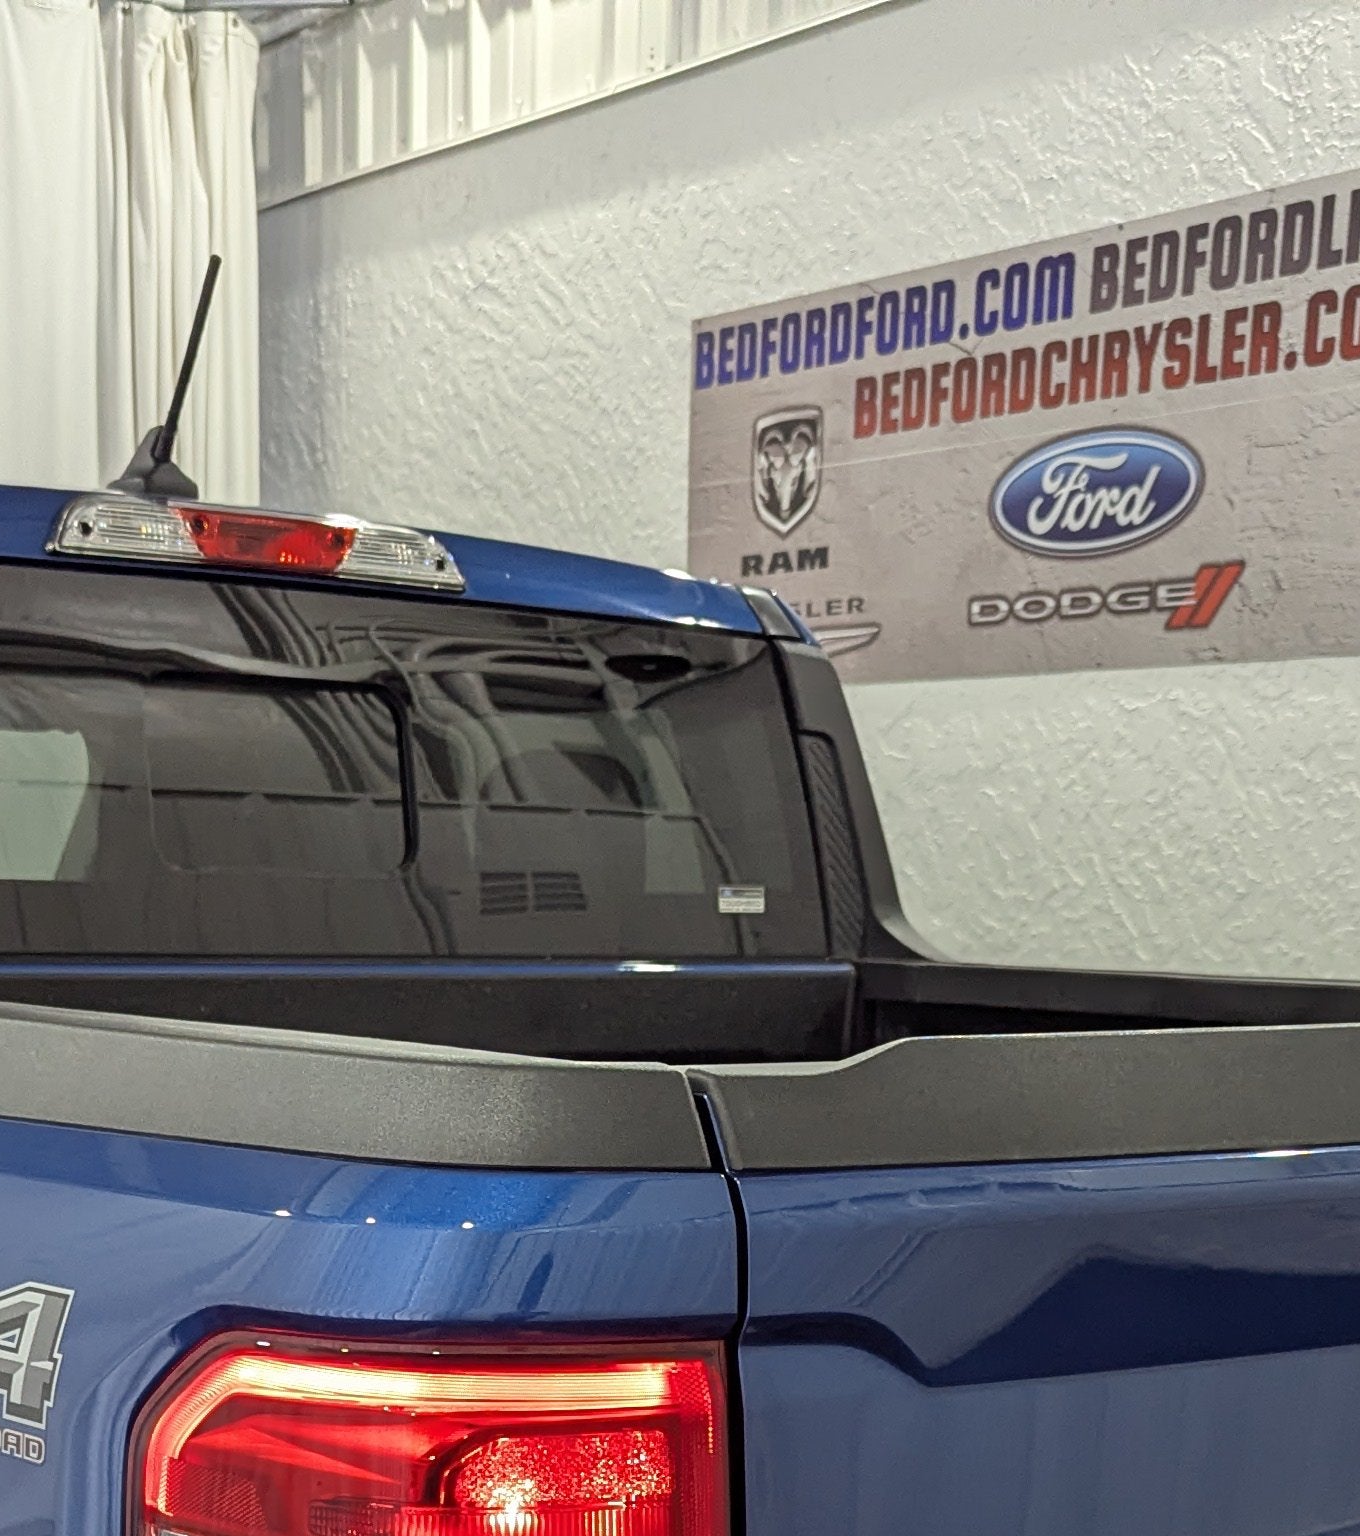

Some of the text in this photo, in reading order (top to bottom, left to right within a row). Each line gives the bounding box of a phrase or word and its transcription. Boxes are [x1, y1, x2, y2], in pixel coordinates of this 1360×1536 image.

[695, 252, 1076, 391] BEDFORDFORD.COM
[1027, 451, 1162, 536] Ford
[741, 546, 829, 577] RAM
[967, 577, 1197, 626] DODGE
